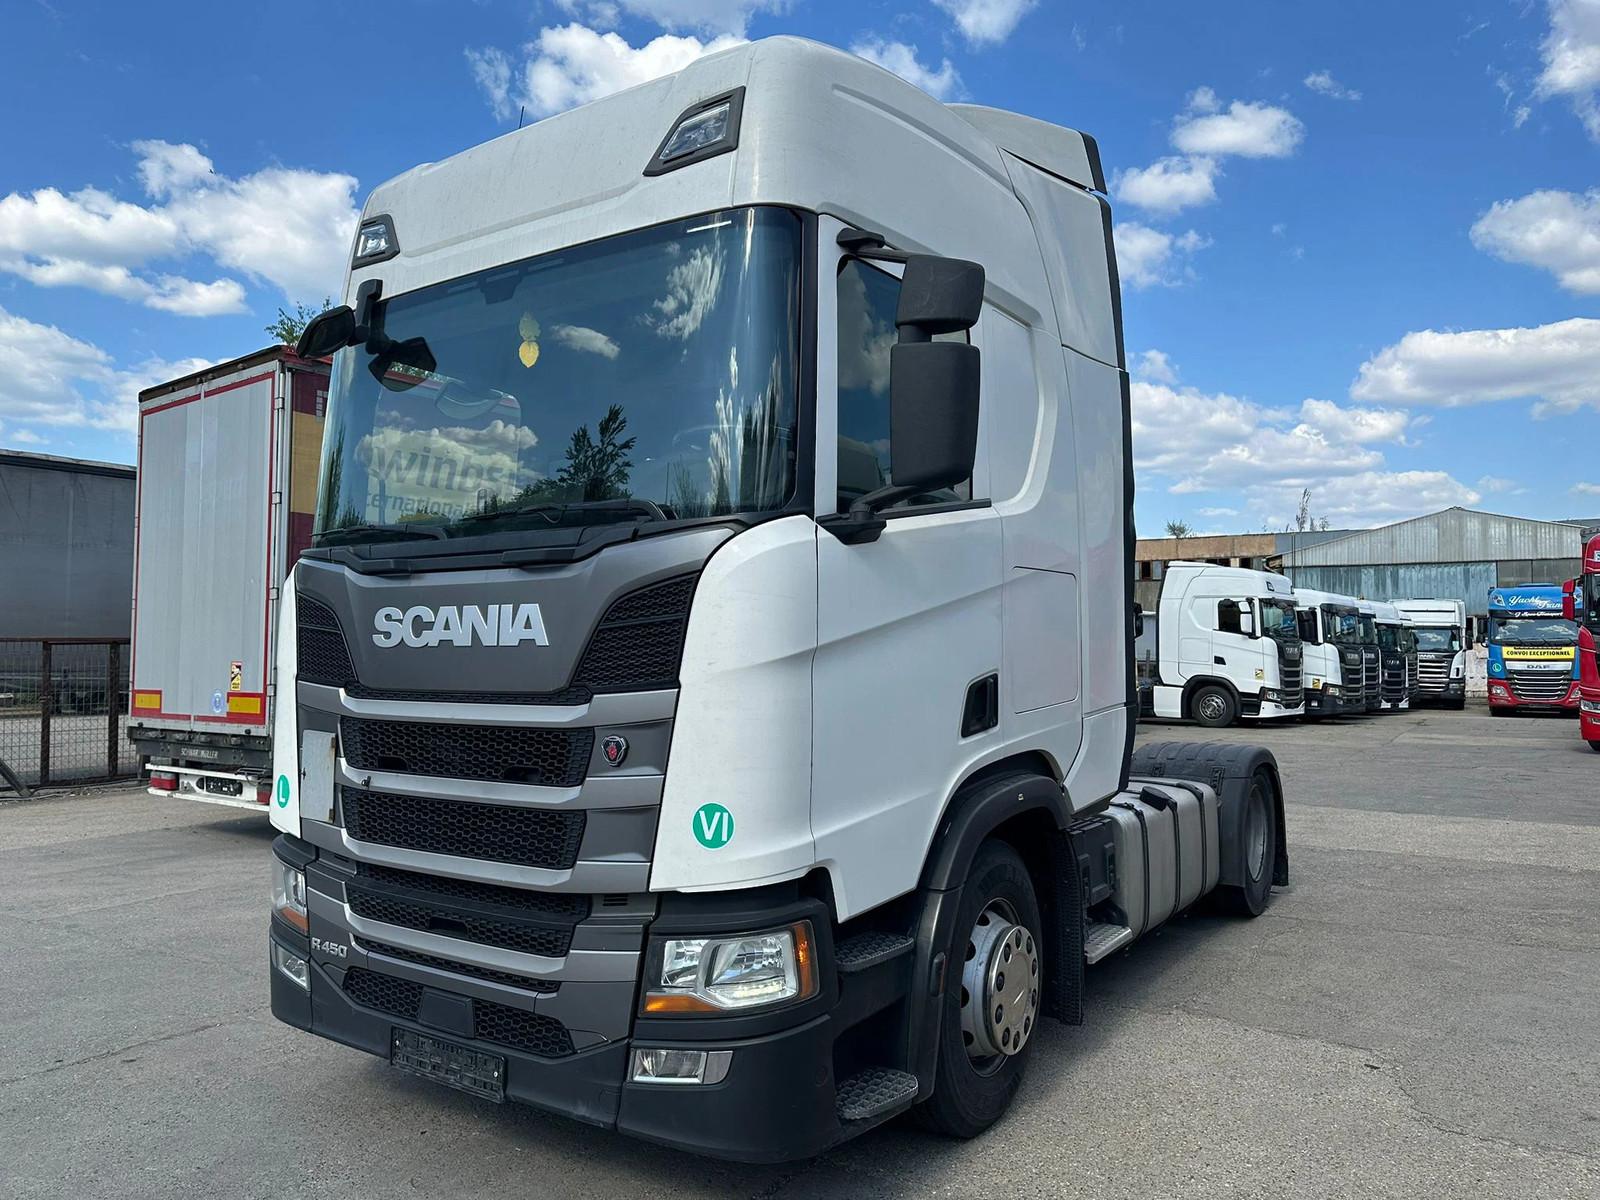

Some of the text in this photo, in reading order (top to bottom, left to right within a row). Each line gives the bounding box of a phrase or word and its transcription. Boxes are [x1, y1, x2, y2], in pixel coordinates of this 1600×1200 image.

[372, 603, 550, 648] SCANIA
[699, 810, 729, 842] VI
[311, 937, 348, 958] R 450
